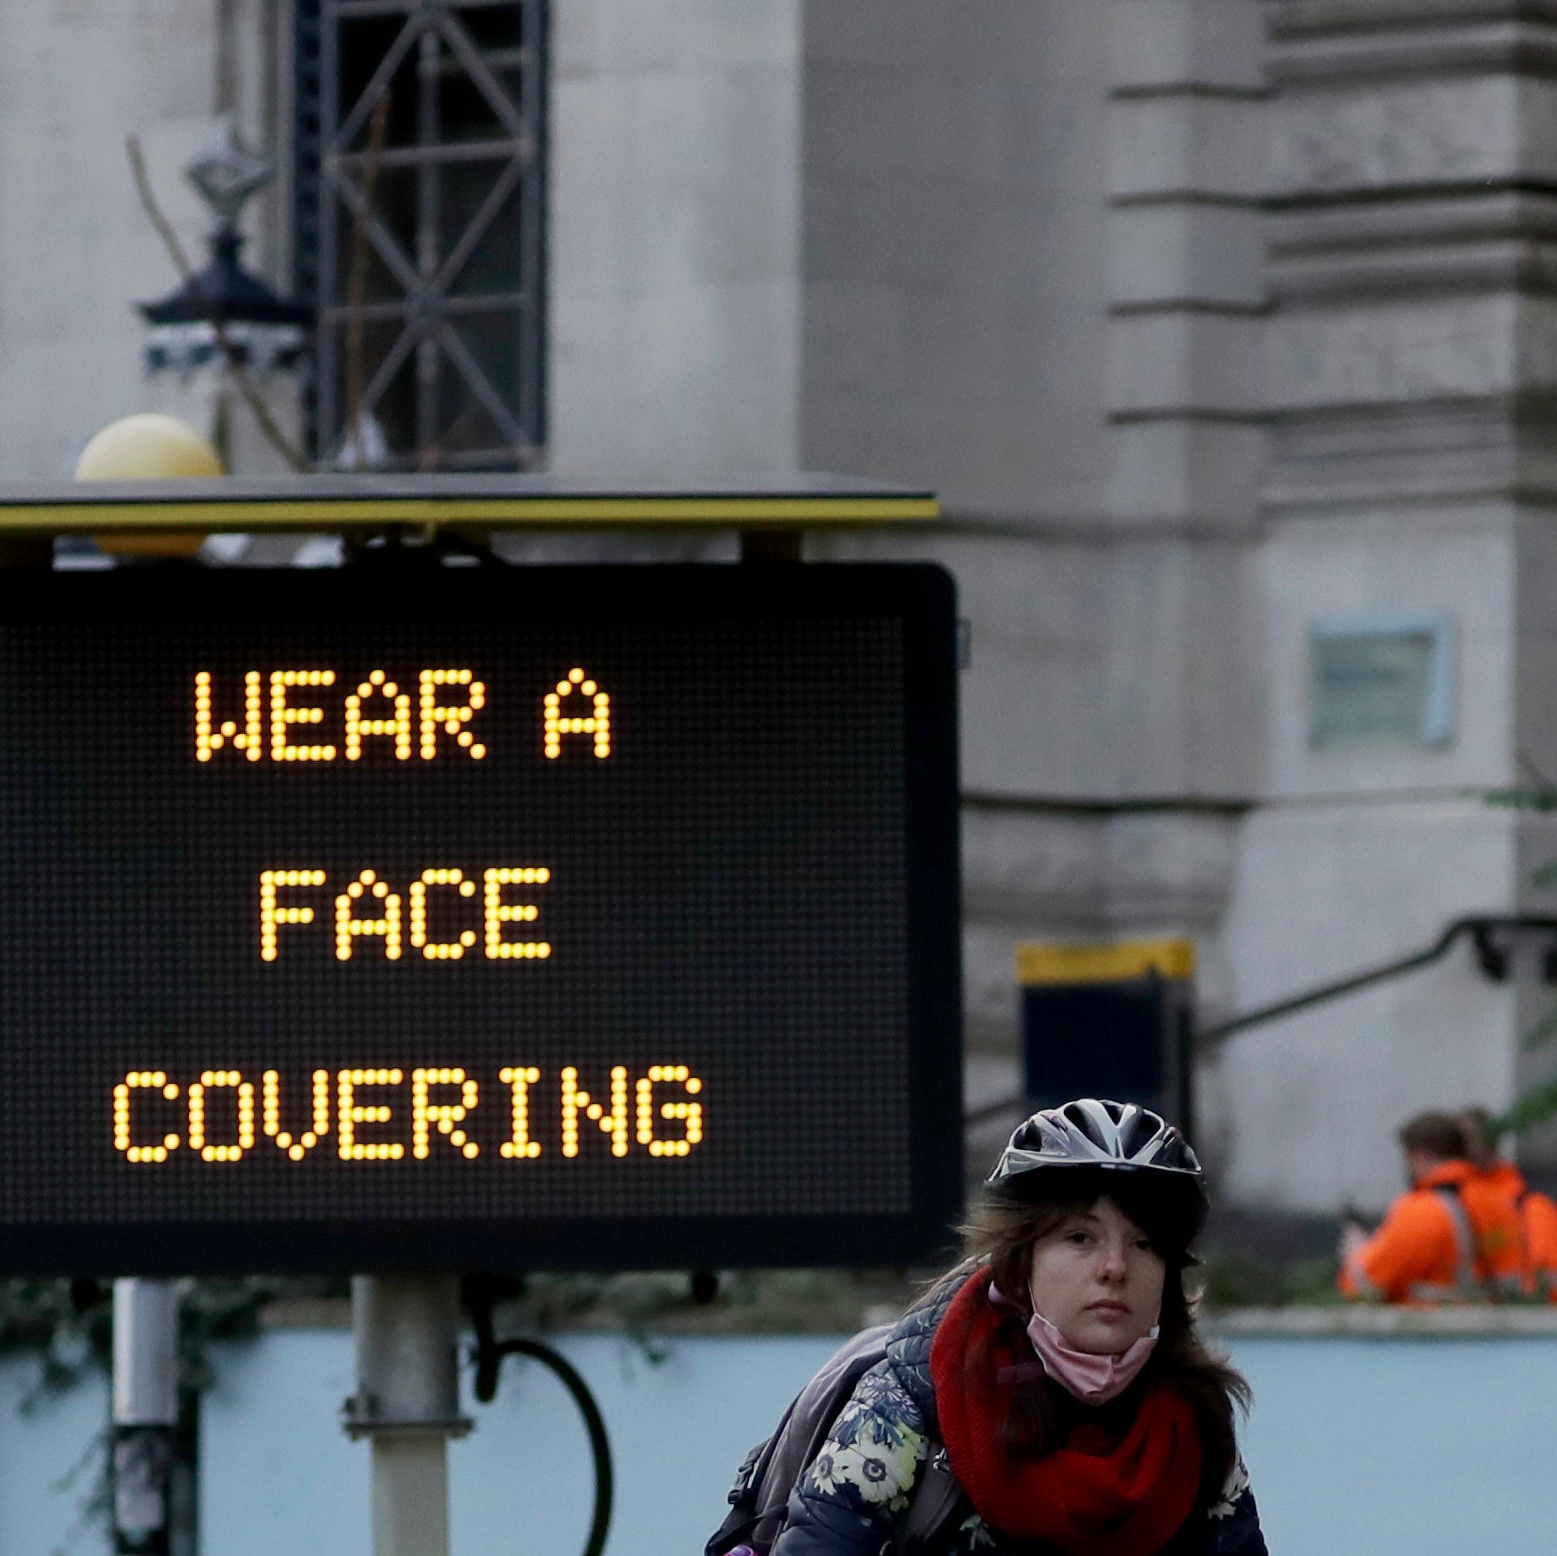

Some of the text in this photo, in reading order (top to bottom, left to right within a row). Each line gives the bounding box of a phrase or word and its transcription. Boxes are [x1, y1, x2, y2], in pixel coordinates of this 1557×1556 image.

[194, 666, 612, 763] WEAR A
[259, 866, 552, 963] FACE
[112, 1064, 704, 1164] COVERING
